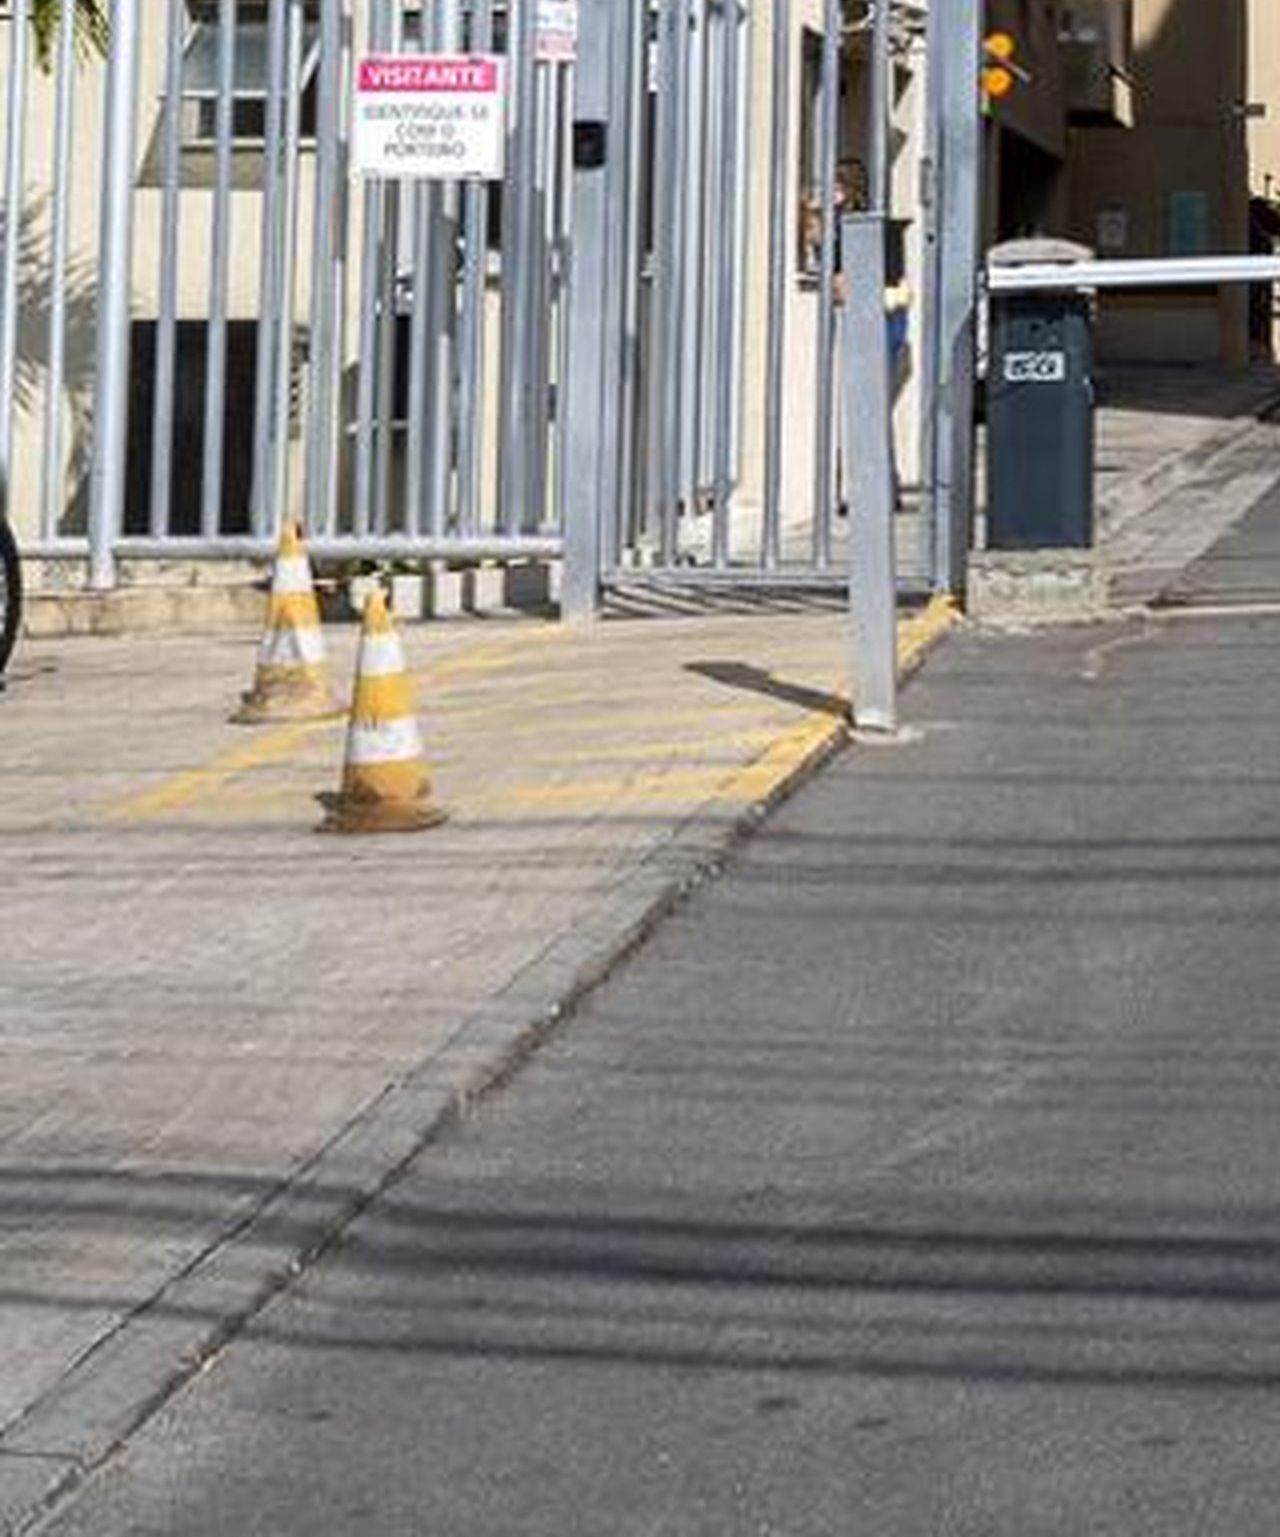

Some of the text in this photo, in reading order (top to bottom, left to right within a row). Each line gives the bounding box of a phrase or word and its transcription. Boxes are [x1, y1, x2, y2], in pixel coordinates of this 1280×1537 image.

[366, 66, 486, 87] VISITANTE
[396, 123, 436, 139] COM
[383, 140, 466, 158] PORTEIRO
